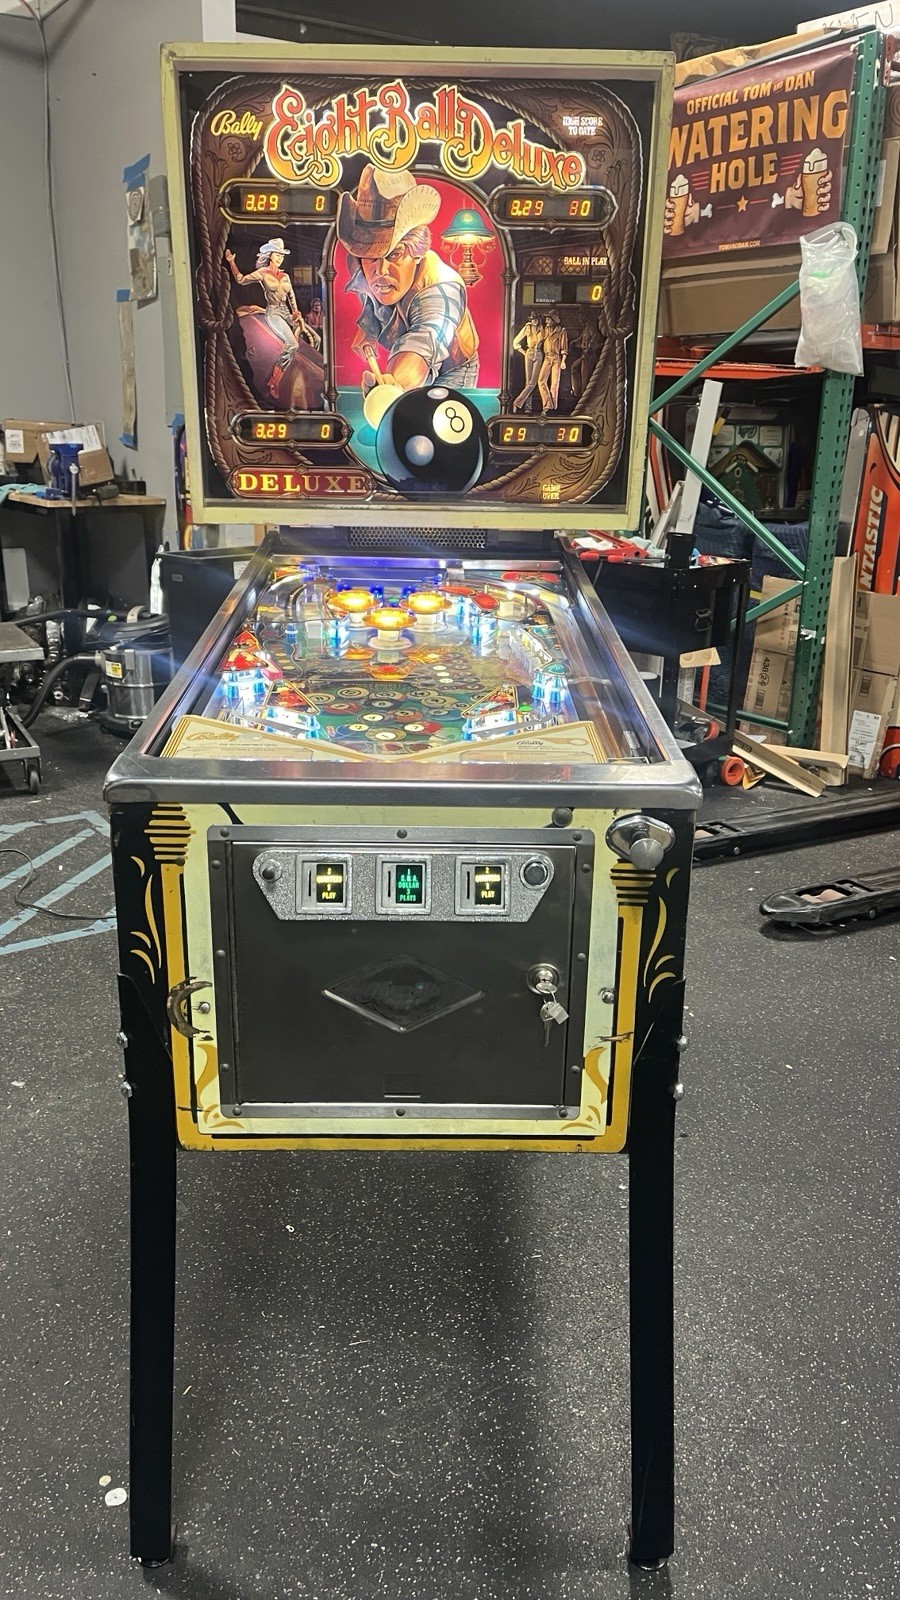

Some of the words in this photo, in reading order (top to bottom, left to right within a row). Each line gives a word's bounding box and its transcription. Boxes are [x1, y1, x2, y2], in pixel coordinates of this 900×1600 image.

[686, 90, 738, 116] OFFICIAL
[743, 82, 772, 102] TOM
[785, 70, 816, 92] DAN
[210, 110, 263, 140] Bally
[581, 116, 604, 126] SCORE
[264, 82, 377, 188] Eight
[369, 79, 457, 171] Ball
[441, 98, 586, 190] Deluxe
[568, 126, 578, 135] TO
[579, 126, 597, 136] DATE
[710, 152, 778, 194] HOLE
[564, 256, 581, 265] BALL
[582, 257, 590, 265] IN
[591, 257, 608, 265] PLAY
[592, 285, 602, 301] 0
[445, 406, 465, 433] 8
[321, 424, 331, 439] 0
[238, 473, 366, 493] DELUXE
[398, 881, 420, 889] DOLLAR
[481, 890, 495, 898] PLAY
